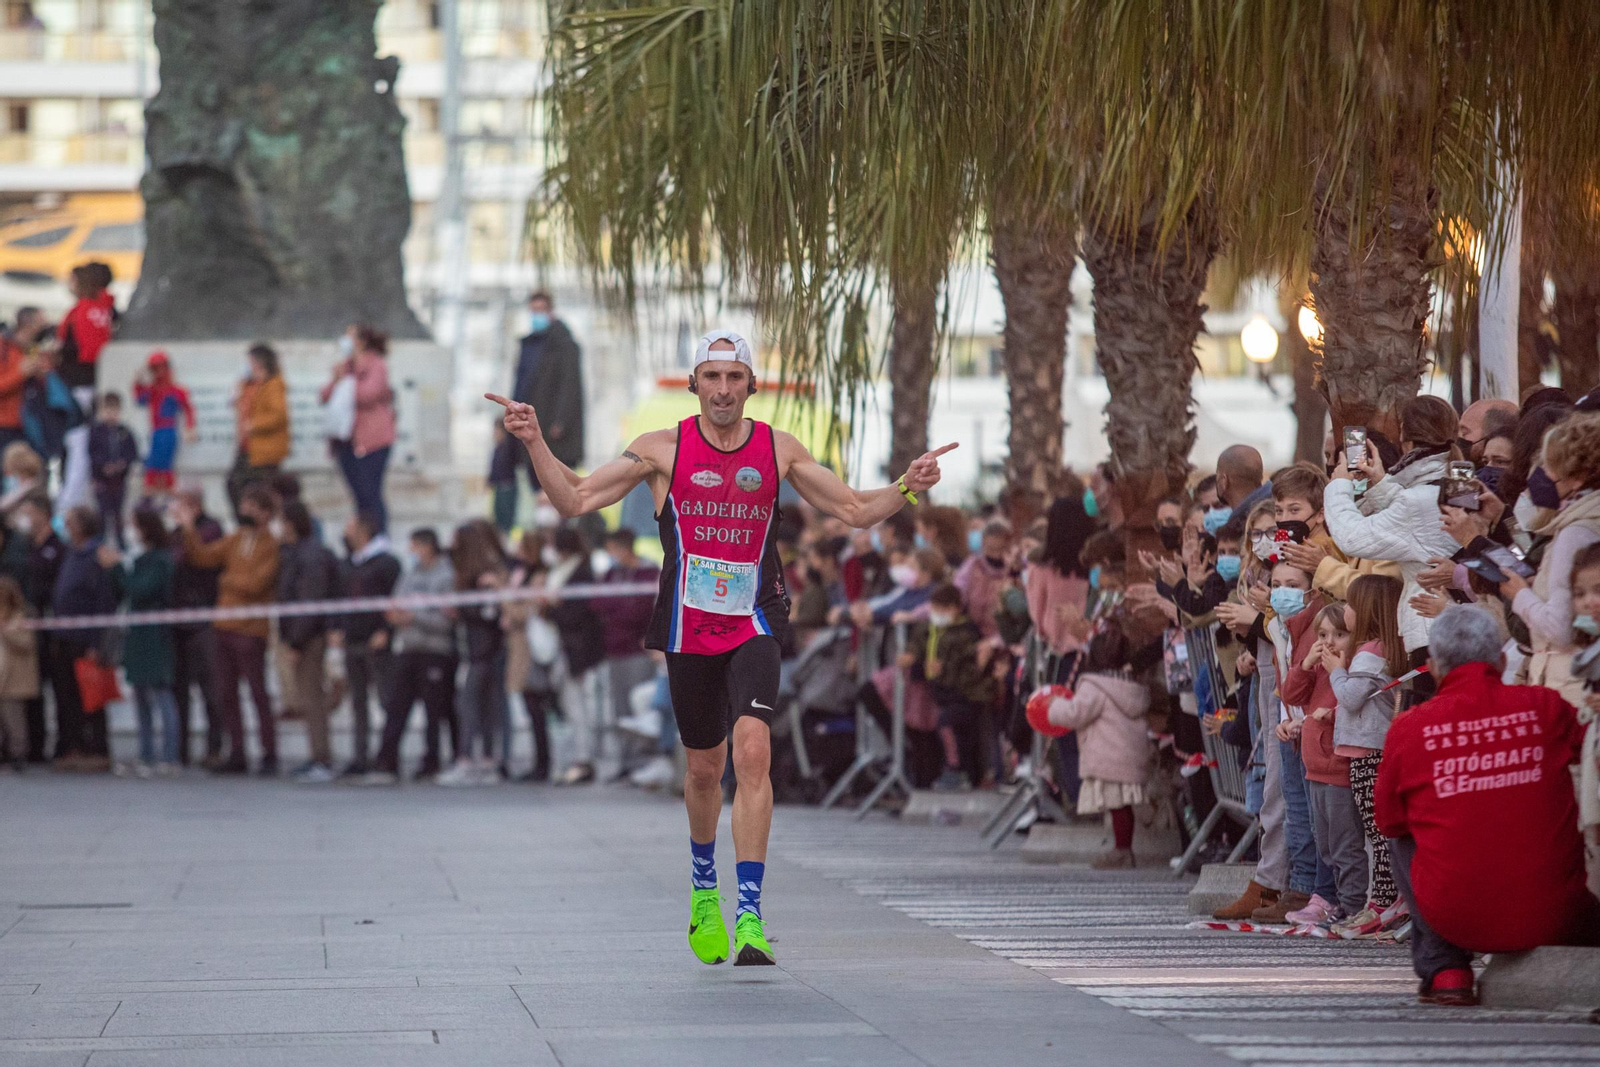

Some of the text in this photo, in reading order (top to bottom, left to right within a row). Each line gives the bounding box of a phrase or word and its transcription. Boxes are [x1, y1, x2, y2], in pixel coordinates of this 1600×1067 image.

[680, 500, 768, 520] GADEIRAS
[694, 525, 754, 544] SPORT
[700, 560, 715, 570] SAN
[717, 563, 752, 574] SILVESTRE
[714, 577, 729, 597] 5
[1422, 710, 1538, 738] SAN SILVESTRE
[1424, 724, 1543, 751] GADITANA
[1433, 745, 1544, 777] FOTÓGRAFO
[1456, 764, 1542, 793] Ermanué
